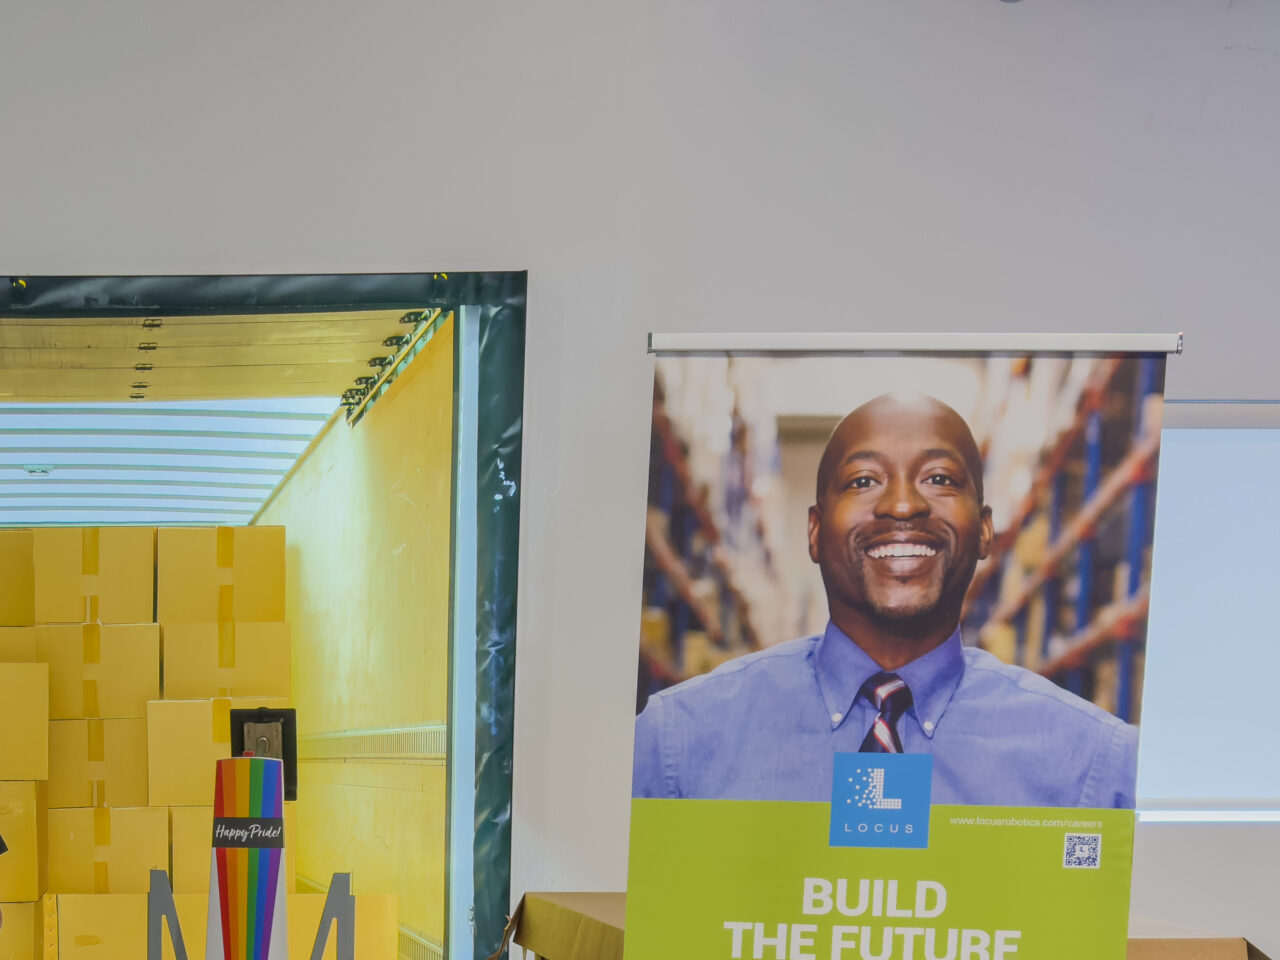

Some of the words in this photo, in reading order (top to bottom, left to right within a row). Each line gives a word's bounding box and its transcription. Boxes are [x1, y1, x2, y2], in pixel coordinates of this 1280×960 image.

[844, 823, 914, 834] LOCUS
[949, 816, 1104, 829] www.locusrobotics.com/careers
[215, 824, 249, 843] Happy
[249, 823, 282, 839] Pride!
[801, 876, 948, 919] BUILD
